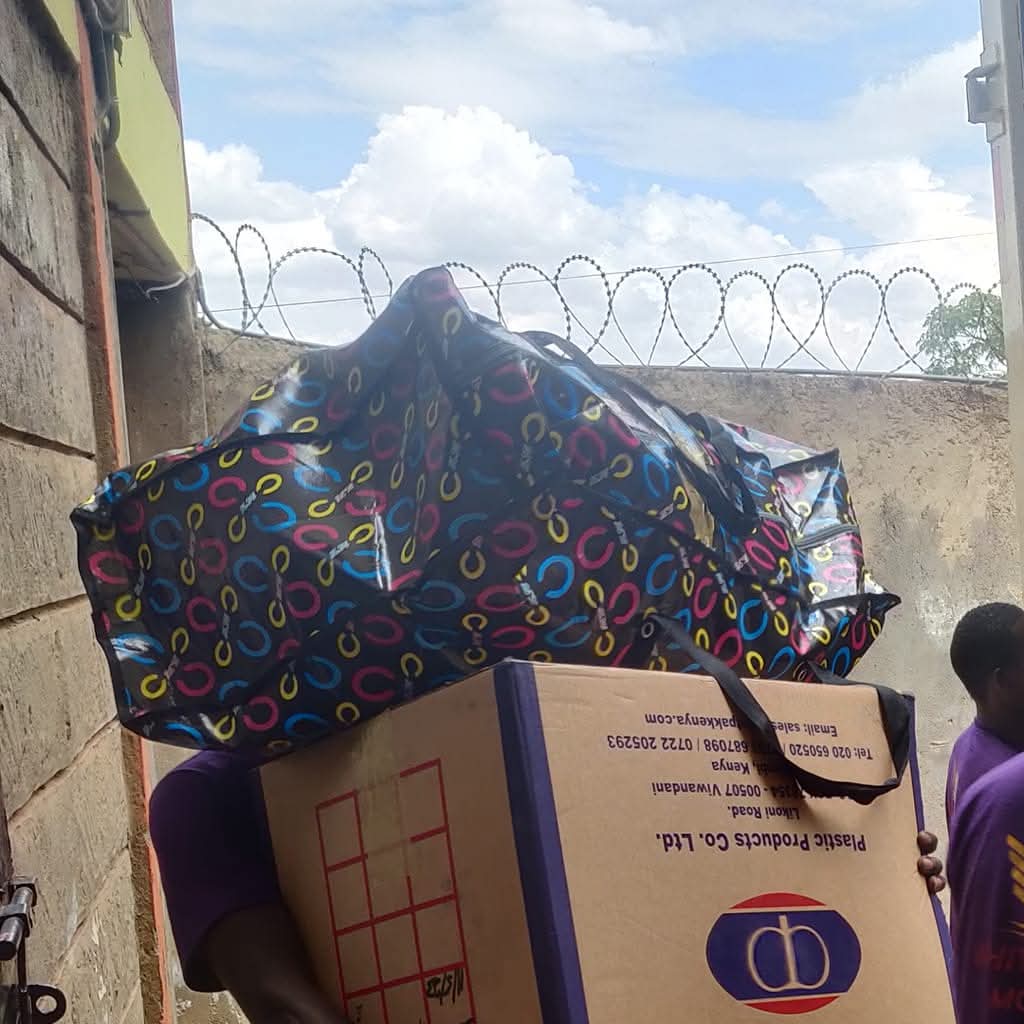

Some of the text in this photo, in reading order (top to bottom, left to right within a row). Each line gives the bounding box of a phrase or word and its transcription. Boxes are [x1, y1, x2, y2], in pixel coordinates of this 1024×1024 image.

[804, 722, 838, 737] Email:
[607, 735, 656, 750] 205293
[660, 737, 692, 751] 0722
[704, 739, 748, 753] 687098
[789, 743, 829, 757] 650520
[832, 745, 852, 758] 020
[853, 747, 873, 760] Tel:
[711, 758, 750, 775] Kenya
[651, 782, 720, 796] Viwandani
[725, 783, 761, 796] 00507
[727, 806, 800, 820] Likoni Road.
[656, 831, 867, 852] Plastic Products Co. Ltd.
